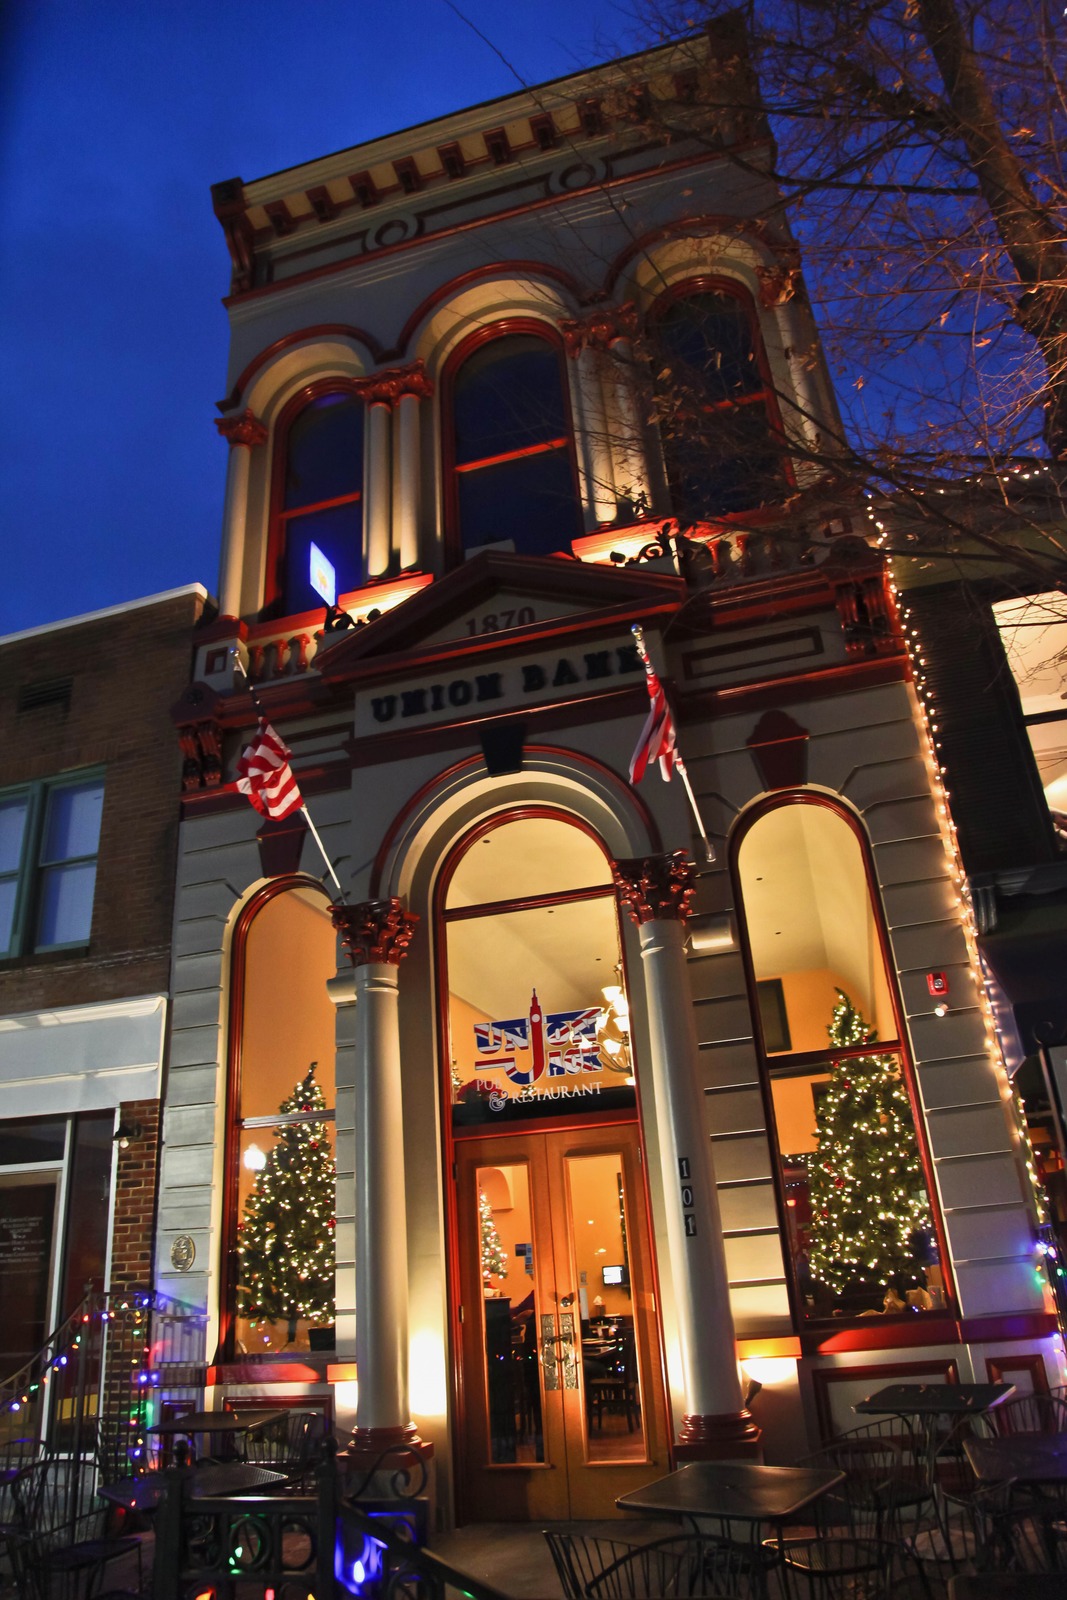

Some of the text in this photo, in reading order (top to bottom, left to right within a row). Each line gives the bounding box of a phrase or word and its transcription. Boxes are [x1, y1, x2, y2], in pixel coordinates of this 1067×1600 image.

[466, 606, 535, 635] 1870
[370, 646, 646, 722] UNION BANK
[476, 1078, 503, 1091] PUB
[488, 1081, 603, 1112] & RESTAURANT
[681, 1160, 694, 1235] 101
